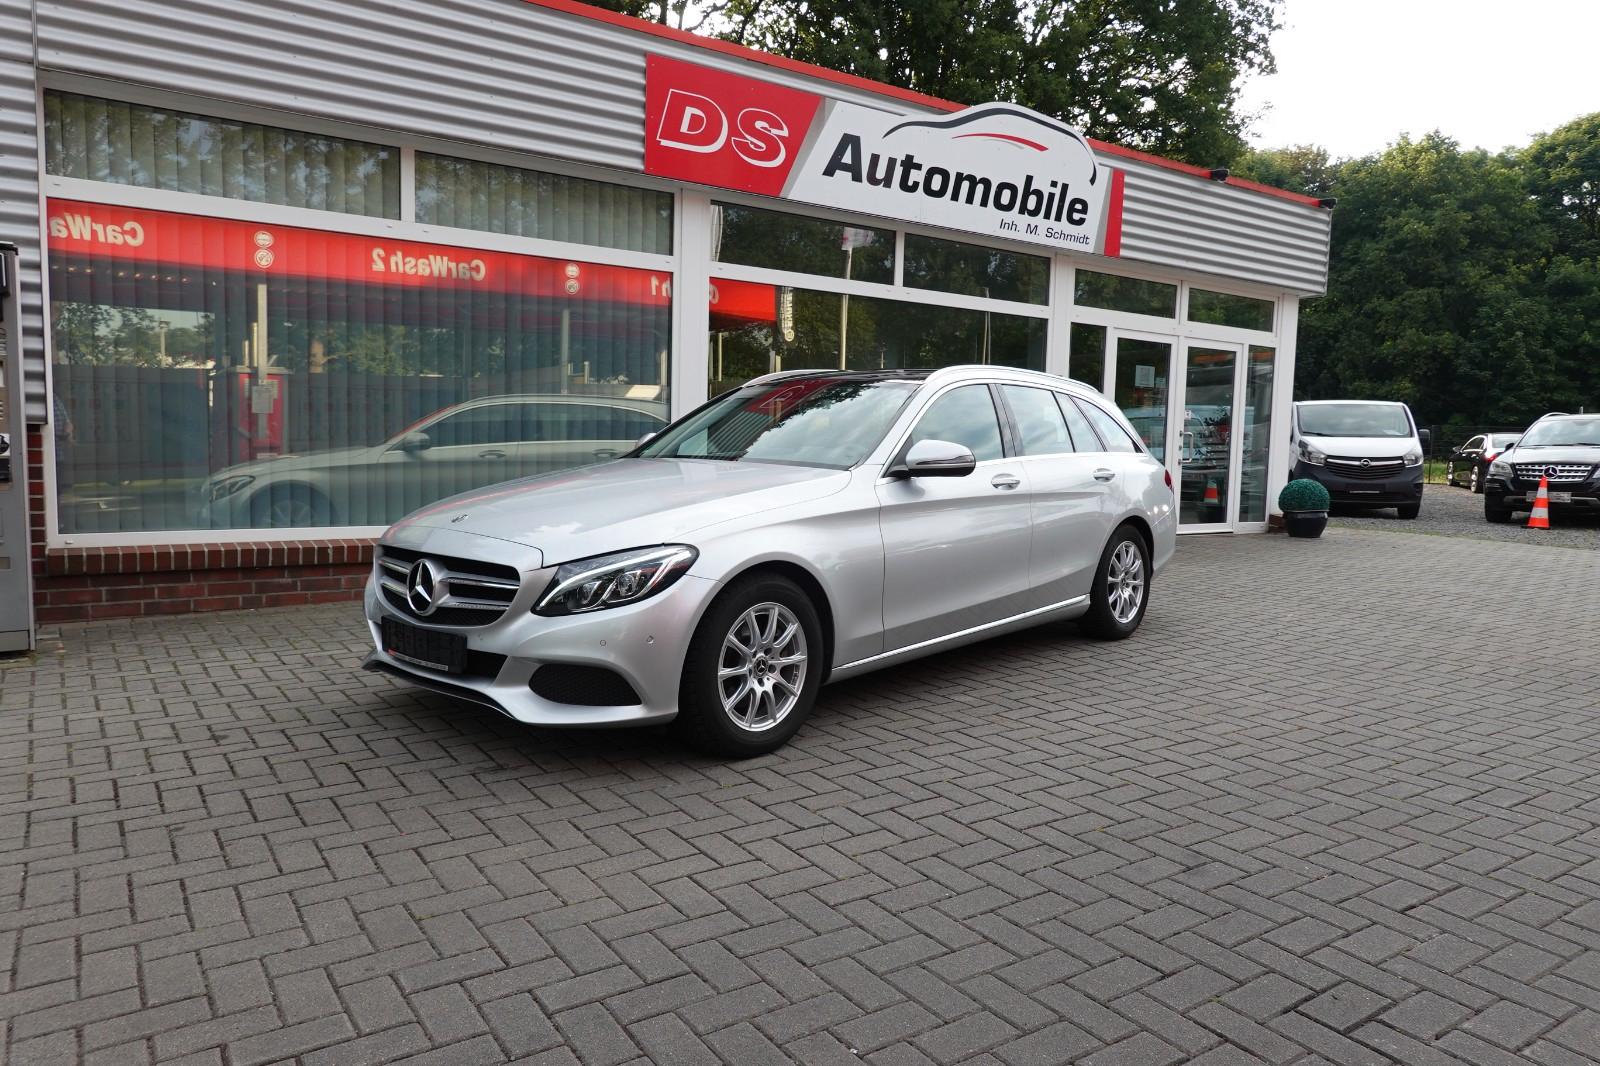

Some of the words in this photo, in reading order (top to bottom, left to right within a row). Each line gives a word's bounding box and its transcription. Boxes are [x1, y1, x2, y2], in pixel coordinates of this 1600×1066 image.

[656, 88, 789, 168] DS
[822, 133, 1089, 226] Automobile
[999, 218, 1020, 233] Inh.
[1025, 223, 1040, 236] M.
[1045, 227, 1090, 245] Schmidt
